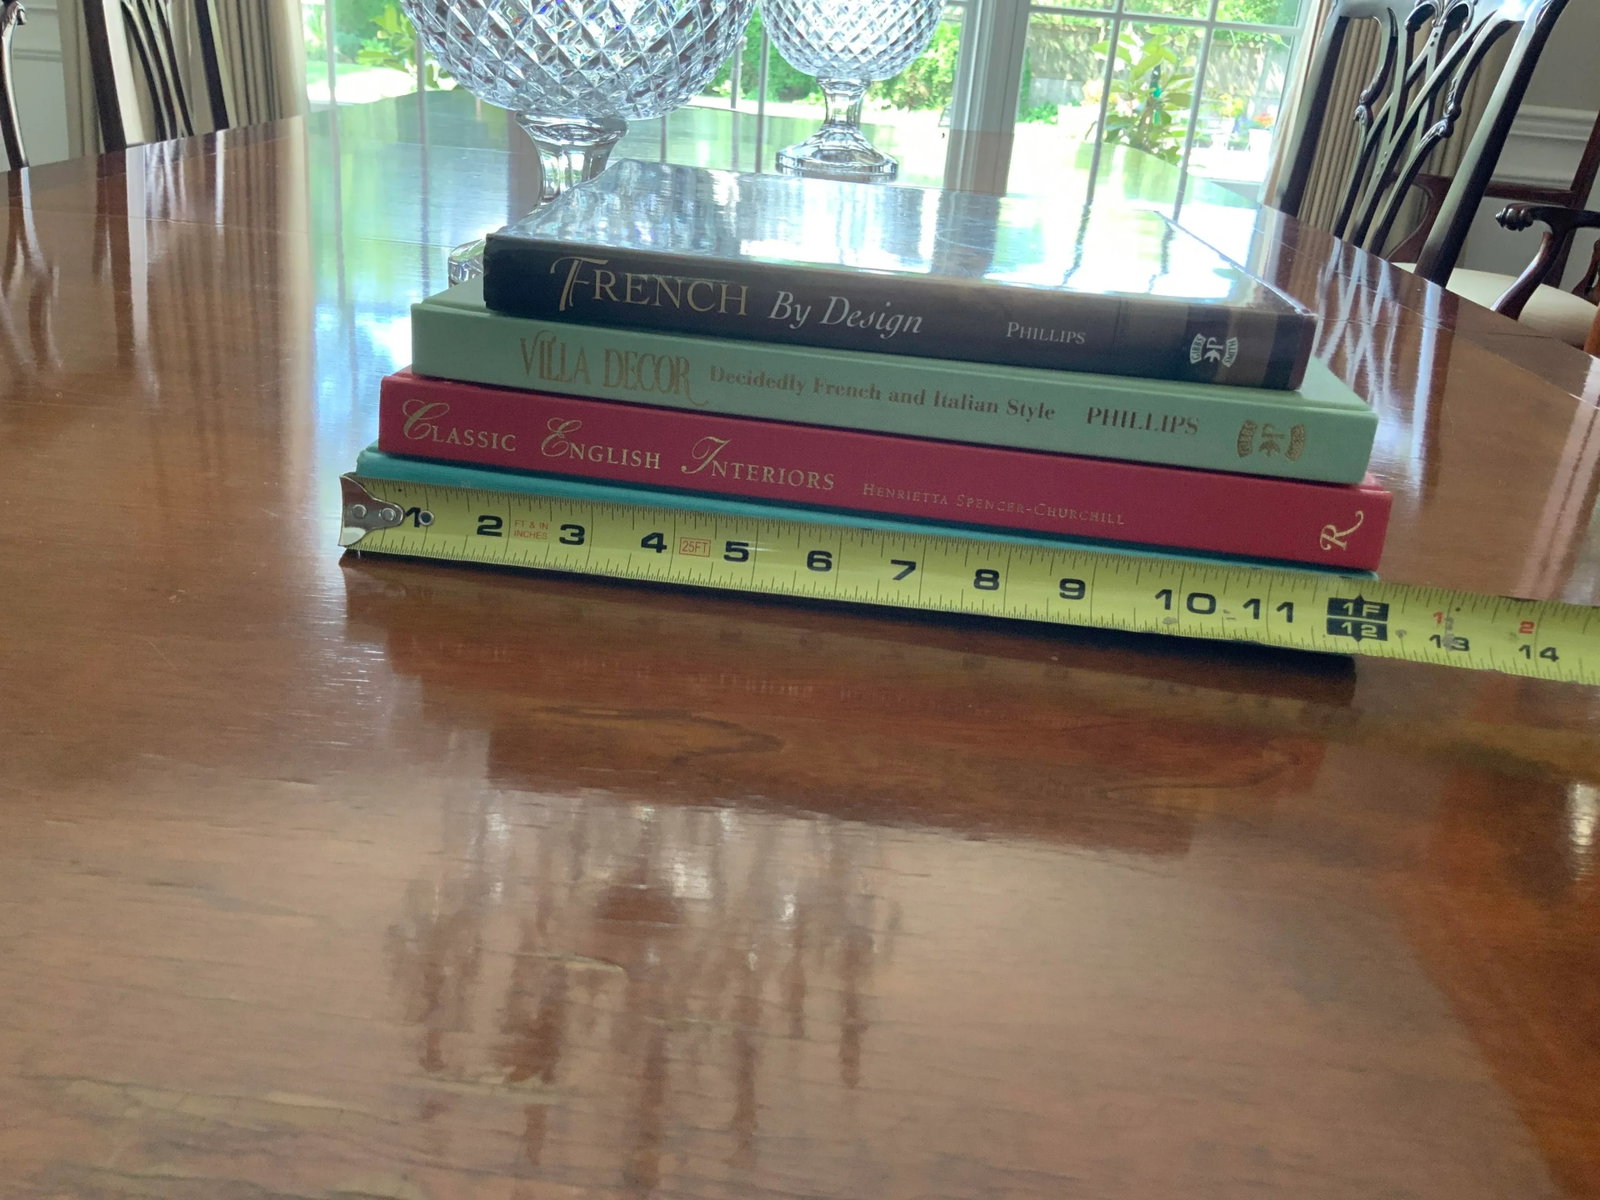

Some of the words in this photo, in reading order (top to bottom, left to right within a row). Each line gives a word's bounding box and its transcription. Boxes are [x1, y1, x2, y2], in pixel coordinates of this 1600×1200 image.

[550, 256, 748, 316] FRENCH
[768, 291, 812, 330] By
[819, 296, 924, 339] Design
[1006, 321, 1087, 345] PHILLIPS
[520, 330, 592, 385] VILLA
[603, 348, 709, 406] DECOR
[710, 365, 806, 396] Decidedly
[813, 376, 881, 401] French
[889, 389, 926, 406] and
[933, 390, 998, 414] Italian
[1006, 398, 1056, 422] Style
[1087, 406, 1199, 436] PHILLIPS
[402, 399, 516, 451] CLASSIC
[541, 417, 661, 469] ENGLISH
[681, 436, 835, 490] INTERIORS
[863, 483, 948, 505] HENRIETTA
[476, 515, 503, 538] 2
[513, 529, 548, 540] INCHES
[539, 521, 549, 530] IN
[559, 524, 586, 546] 3
[1319, 510, 1365, 551] R
[641, 532, 667, 553] 4
[681, 539, 708, 555] 25FT
[724, 541, 750, 563] 5
[807, 550, 833, 572] 6
[890, 559, 917, 581] 7
[973, 568, 1000, 591] 8
[1059, 578, 1086, 600] 9
[1155, 588, 1217, 615] 10
[1242, 598, 1294, 623] 11
[1343, 602, 1381, 617] 1F
[1341, 621, 1379, 638] 12
[1518, 620, 1535, 635] 2
[1429, 633, 1470, 652] 13
[1518, 643, 1560, 663] 14
